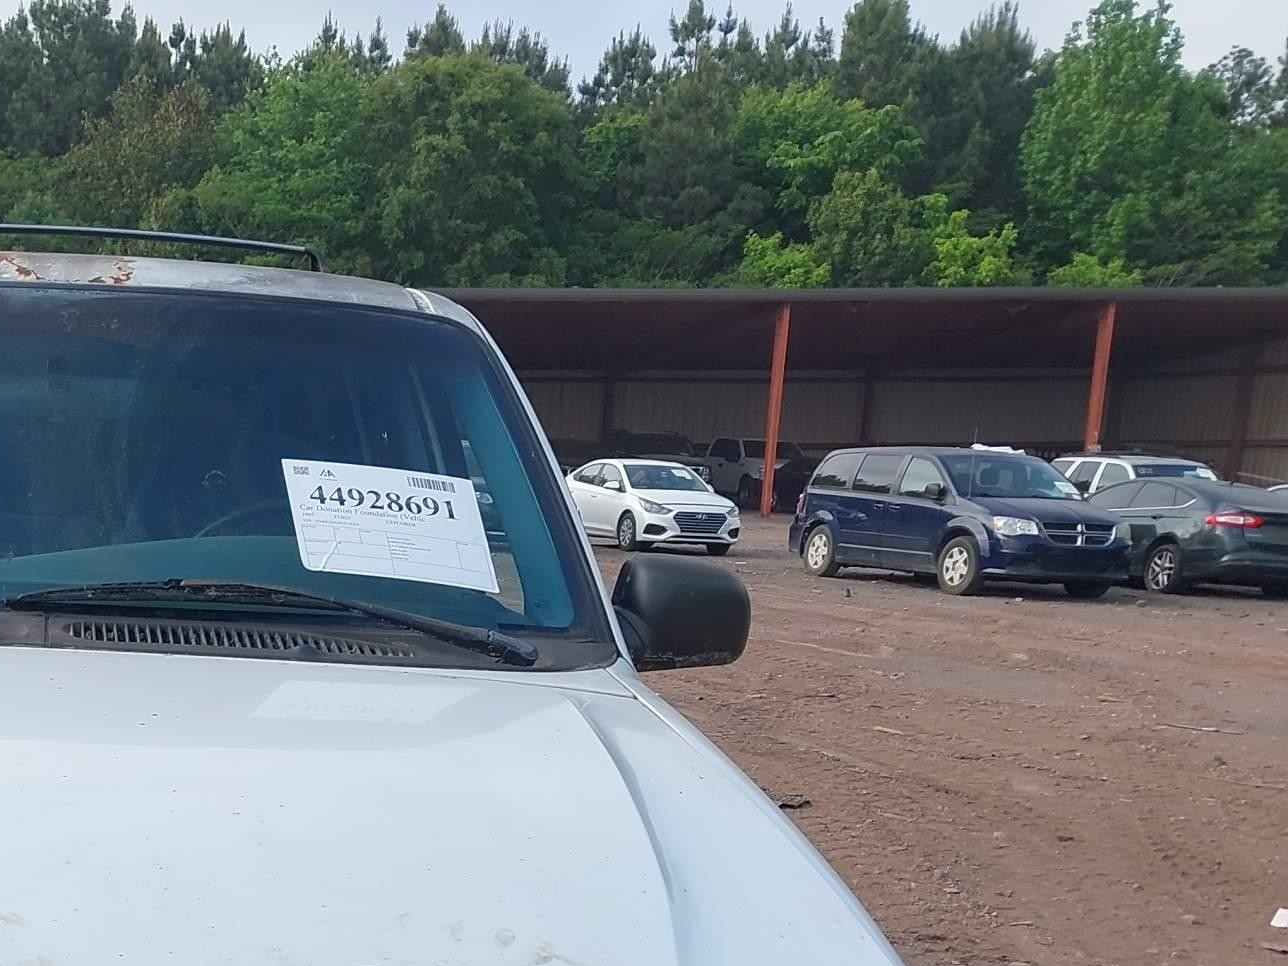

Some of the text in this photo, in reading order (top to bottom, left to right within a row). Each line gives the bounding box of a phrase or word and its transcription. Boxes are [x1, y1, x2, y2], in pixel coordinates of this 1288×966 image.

[299, 503, 313, 511] Car
[316, 505, 353, 515] Donation
[355, 509, 399, 519] Foundation
[310, 485, 459, 520] 44928691
